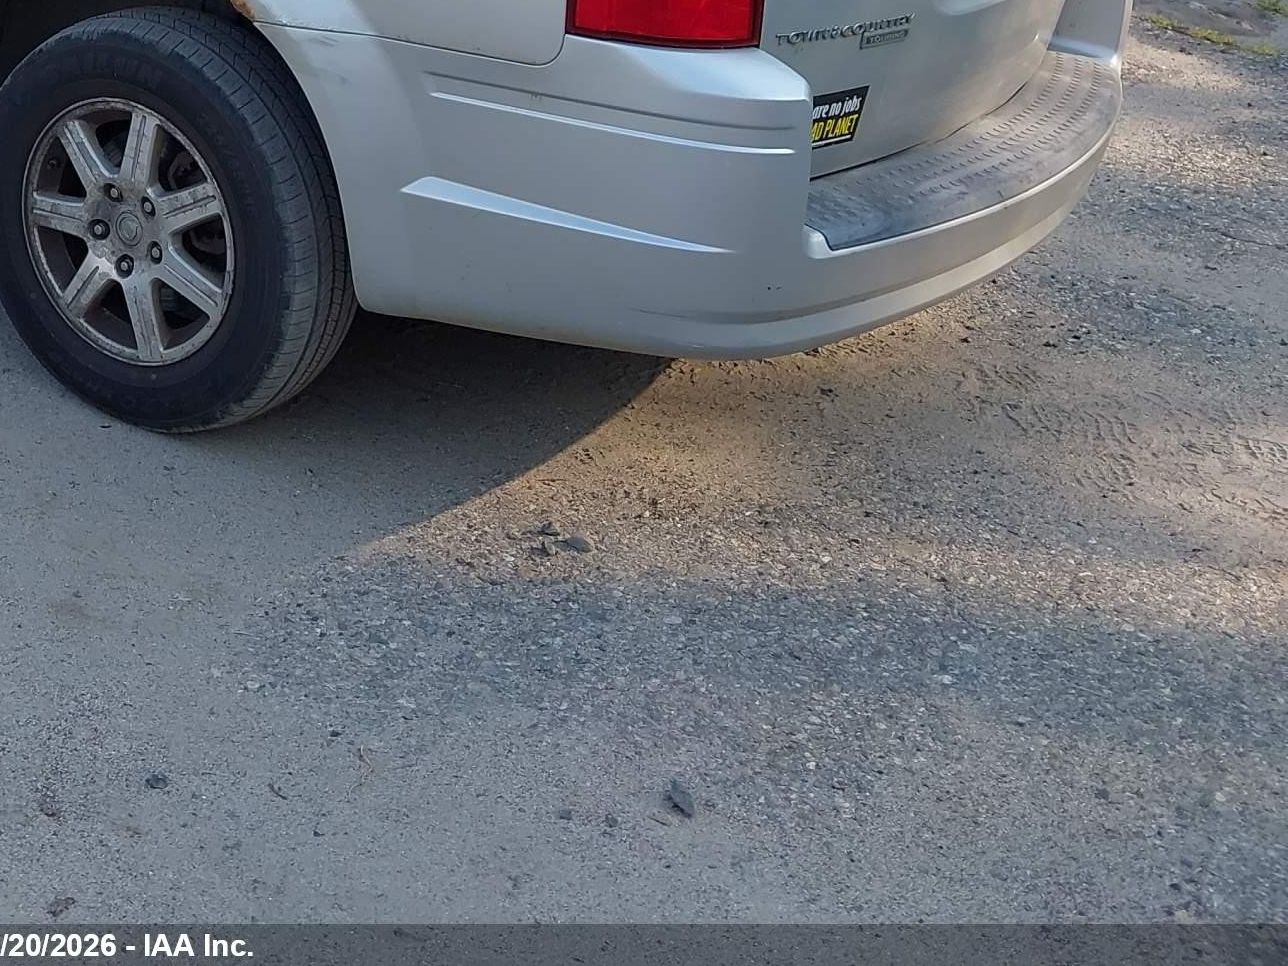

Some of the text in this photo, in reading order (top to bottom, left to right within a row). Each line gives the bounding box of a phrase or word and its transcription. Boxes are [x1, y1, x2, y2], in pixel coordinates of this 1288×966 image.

[812, 95, 862, 120] are no jobs
[823, 114, 859, 138] PLANET
